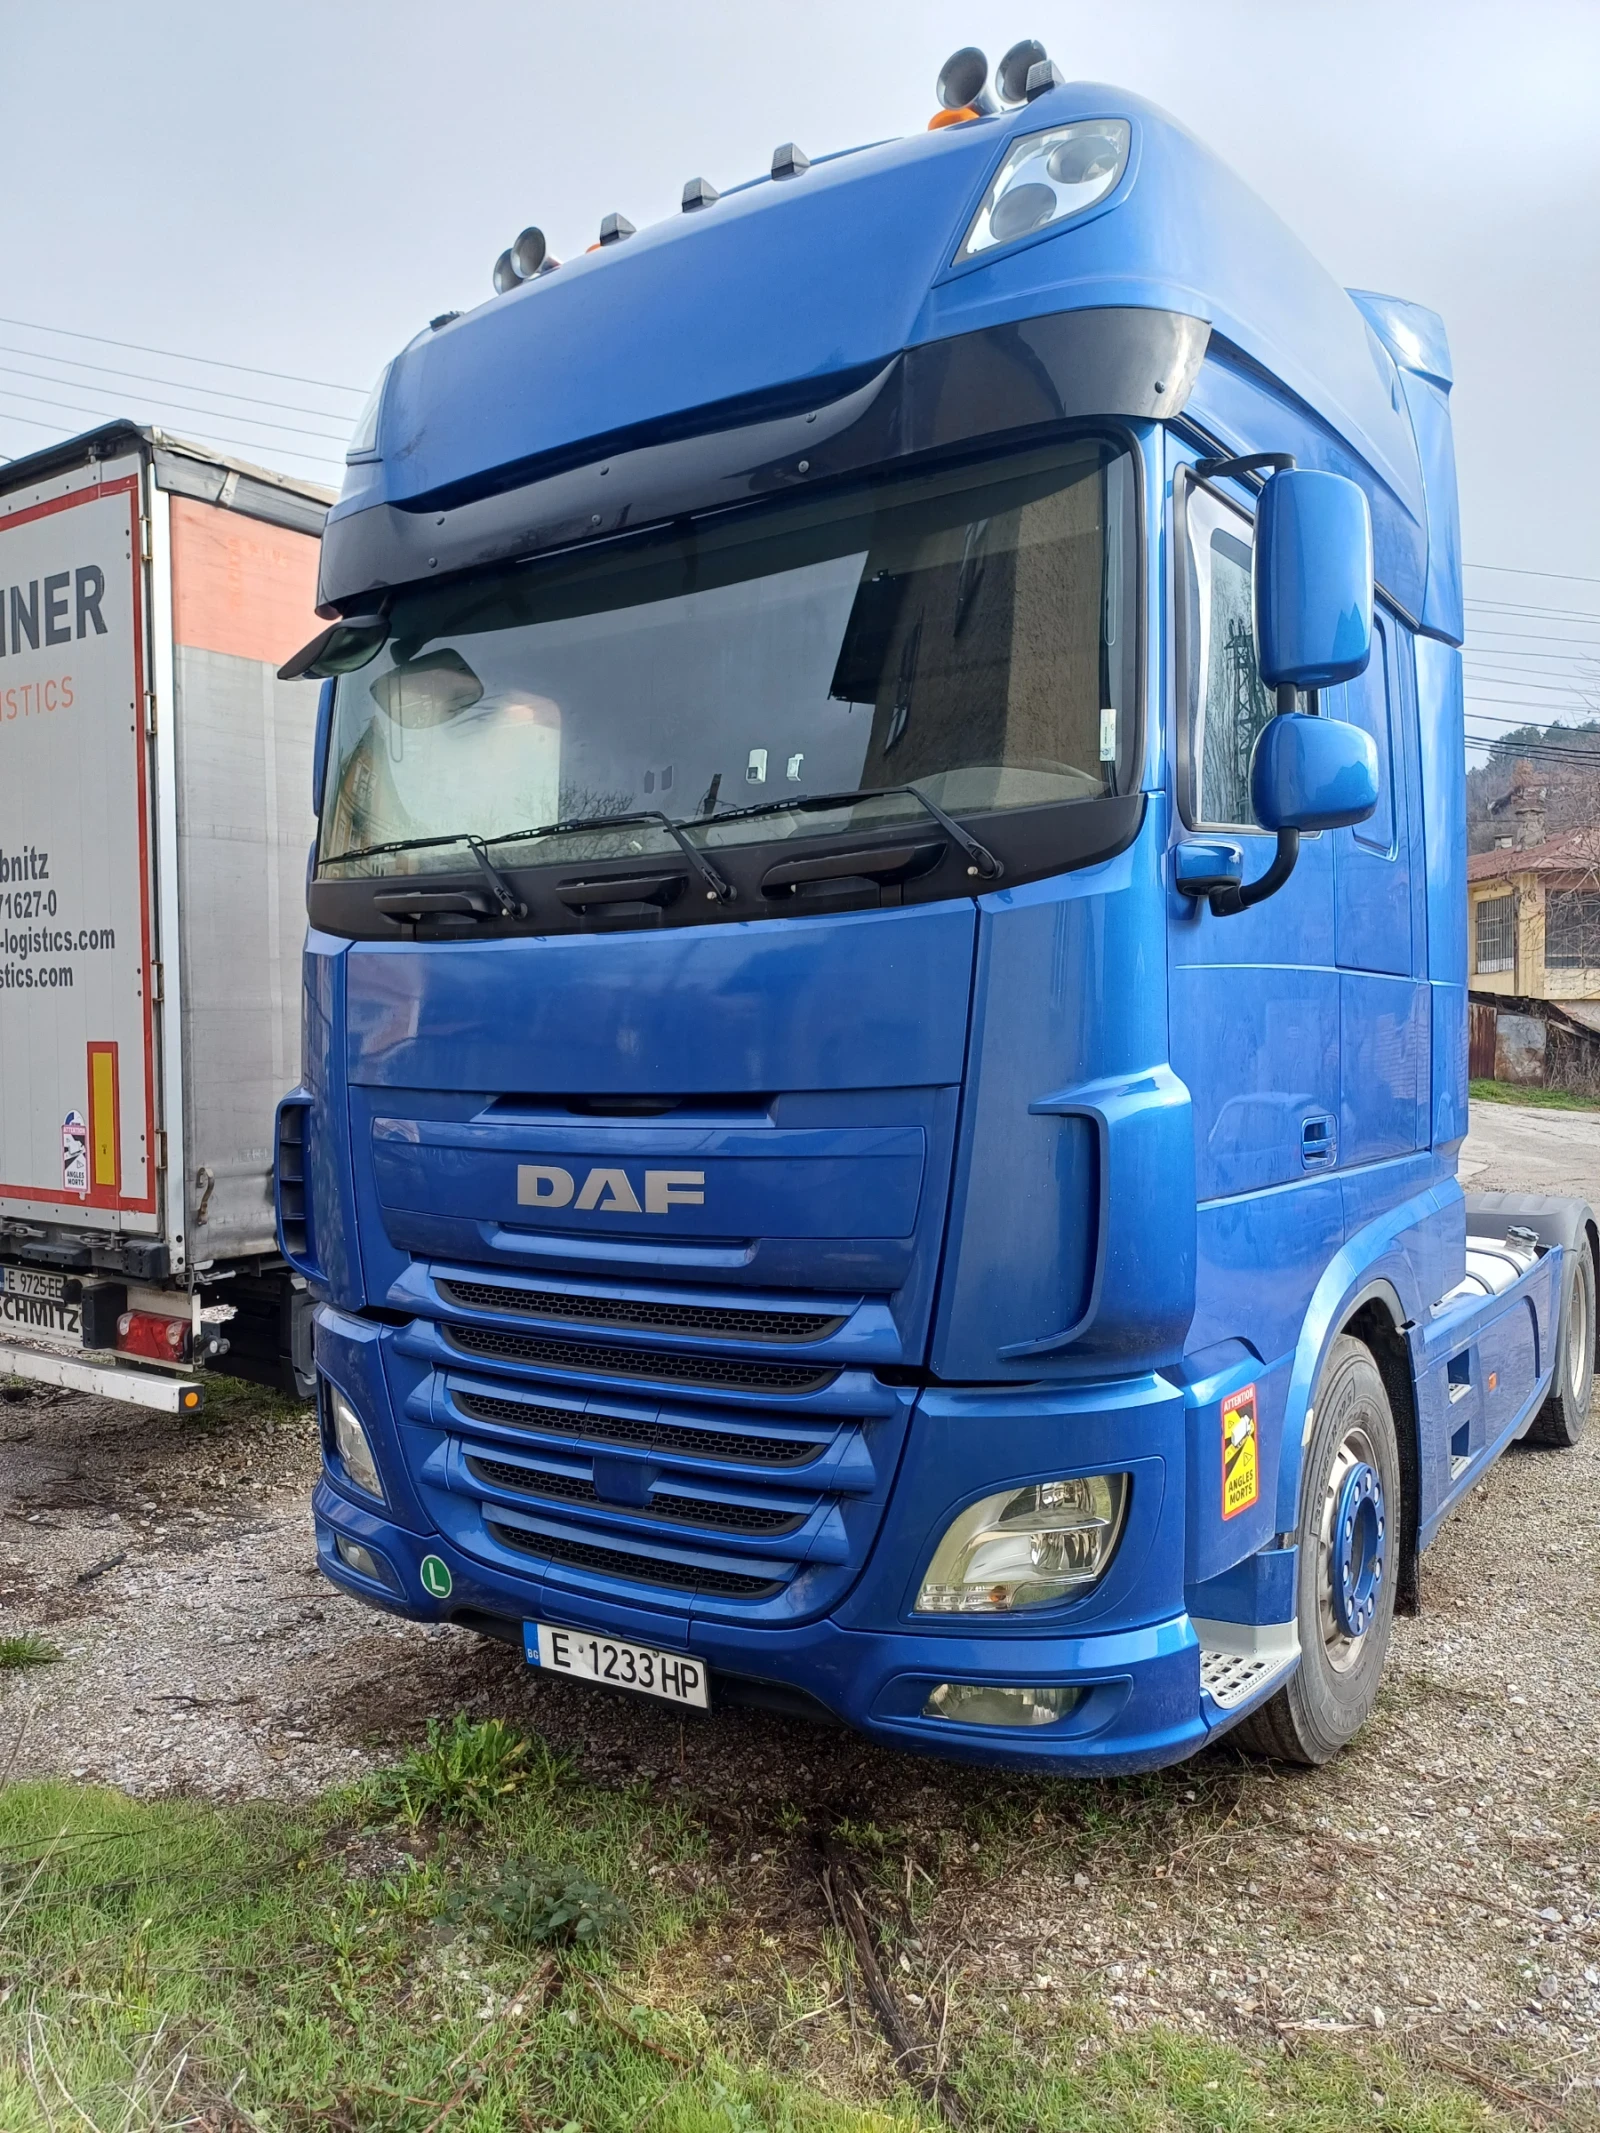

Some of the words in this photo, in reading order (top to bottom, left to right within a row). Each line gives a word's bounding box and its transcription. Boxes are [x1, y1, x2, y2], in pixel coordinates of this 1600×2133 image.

[66, 1171, 85, 1179] ANGLES
[67, 1178, 85, 1186] MORTS
[517, 1164, 705, 1214] DAF
[8, 1270, 16, 1291] E
[20, 1272, 47, 1296] 9725
[0, 1296, 79, 1334] CHMITZ
[1223, 1387, 1254, 1412] ATTENTION
[1228, 1469, 1254, 1493] ANGLES
[1229, 1482, 1253, 1506] MORTS
[428, 1562, 446, 1592] L
[527, 1648, 539, 1660] BG
[551, 1631, 571, 1668] E
[589, 1641, 655, 1688] 1233
[661, 1657, 699, 1699] HP
